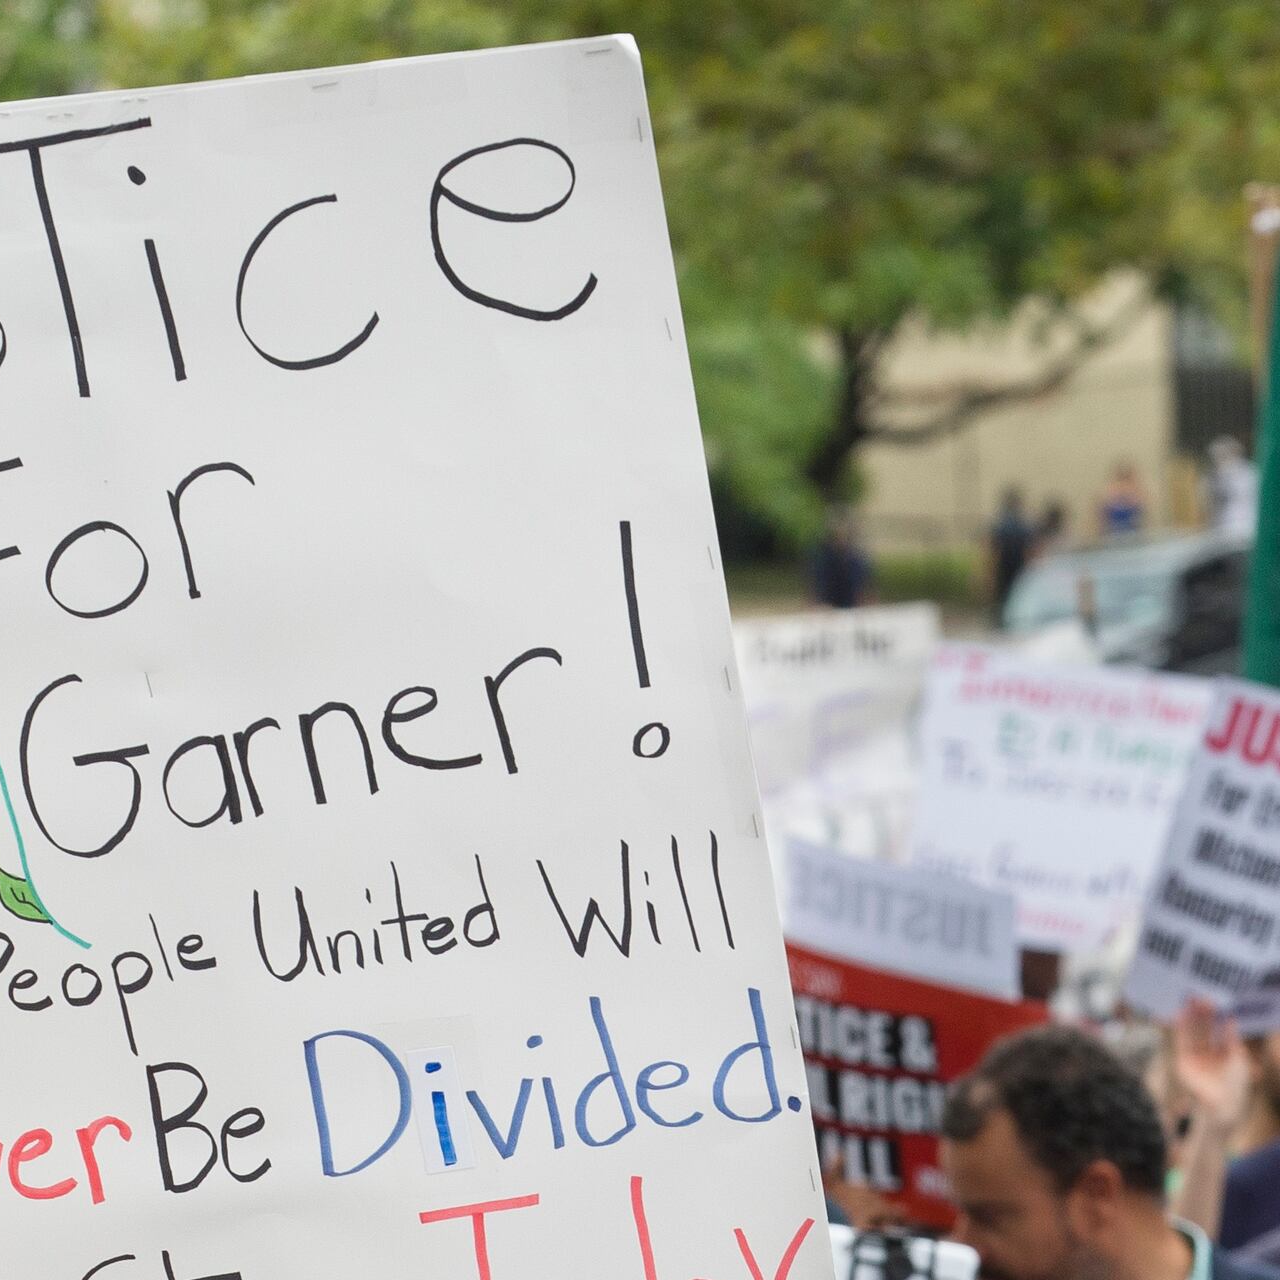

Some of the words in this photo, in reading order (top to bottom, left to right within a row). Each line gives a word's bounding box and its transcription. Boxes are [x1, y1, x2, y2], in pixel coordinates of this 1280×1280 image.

[253, 854, 500, 981] United
[537, 831, 735, 958] Will
[145, 1062, 272, 1195] Be
[303, 988, 803, 1178] Divided.
[797, 995, 899, 1069] TICE
